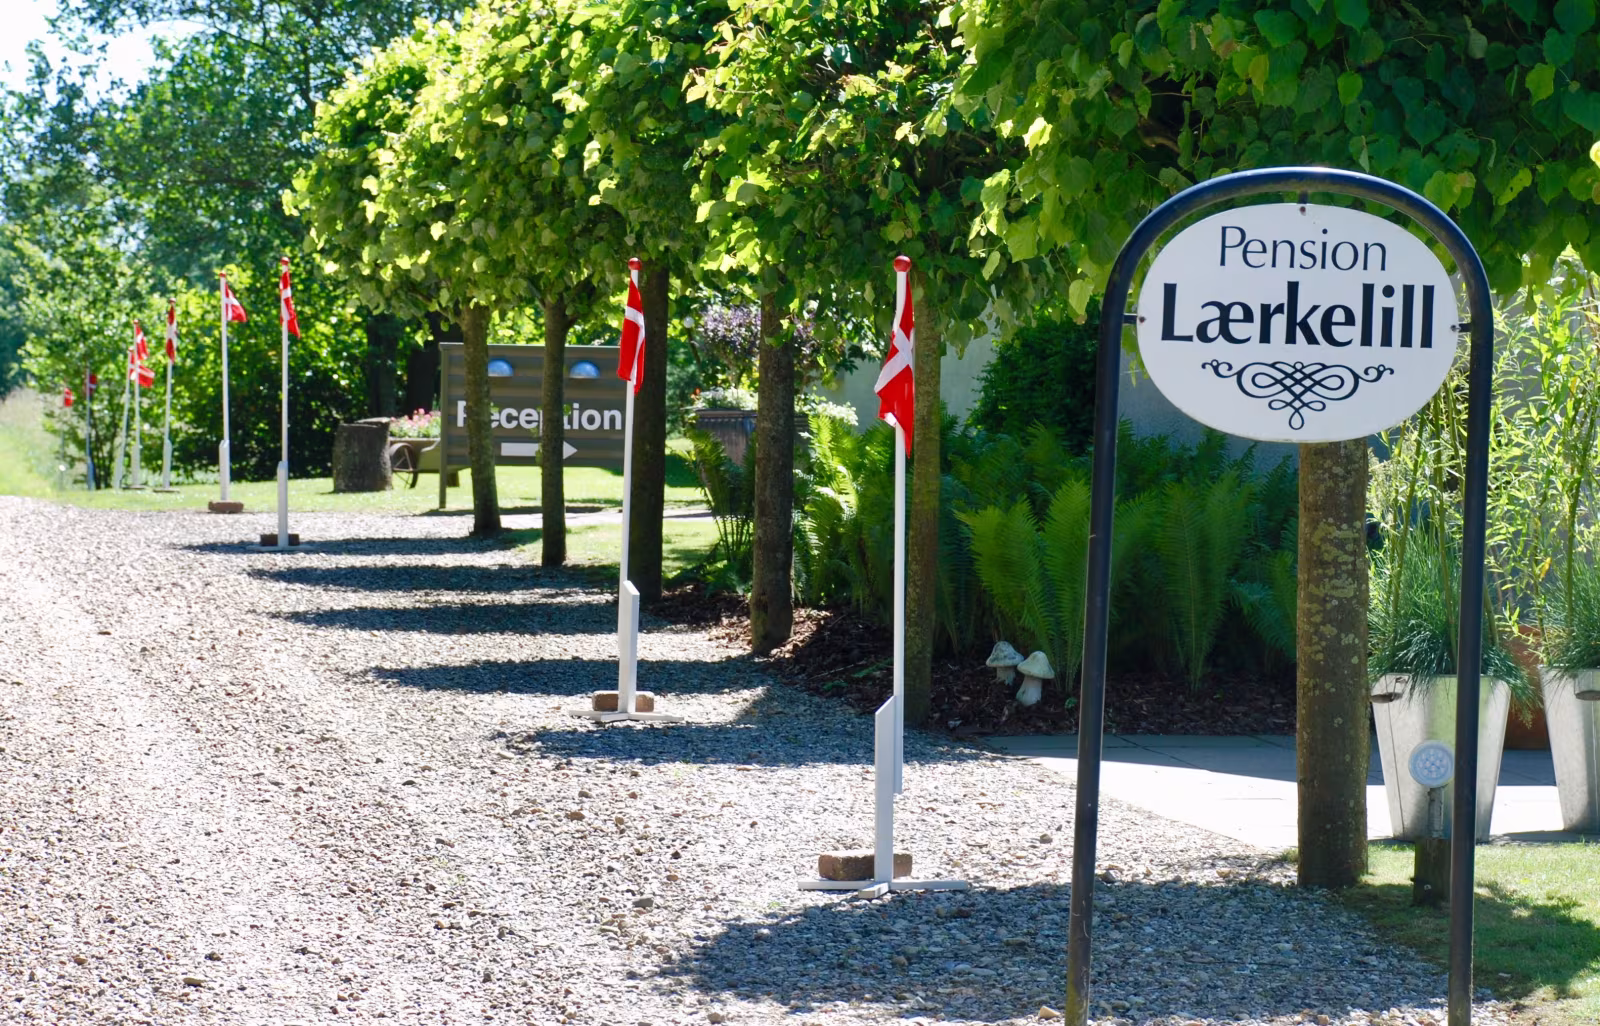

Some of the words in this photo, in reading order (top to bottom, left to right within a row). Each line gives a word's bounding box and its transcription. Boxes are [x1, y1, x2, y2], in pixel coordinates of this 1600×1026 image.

[1219, 225, 1387, 271] Pension
[1161, 281, 1435, 349] Lærkelill
[456, 400, 623, 437] ceion
